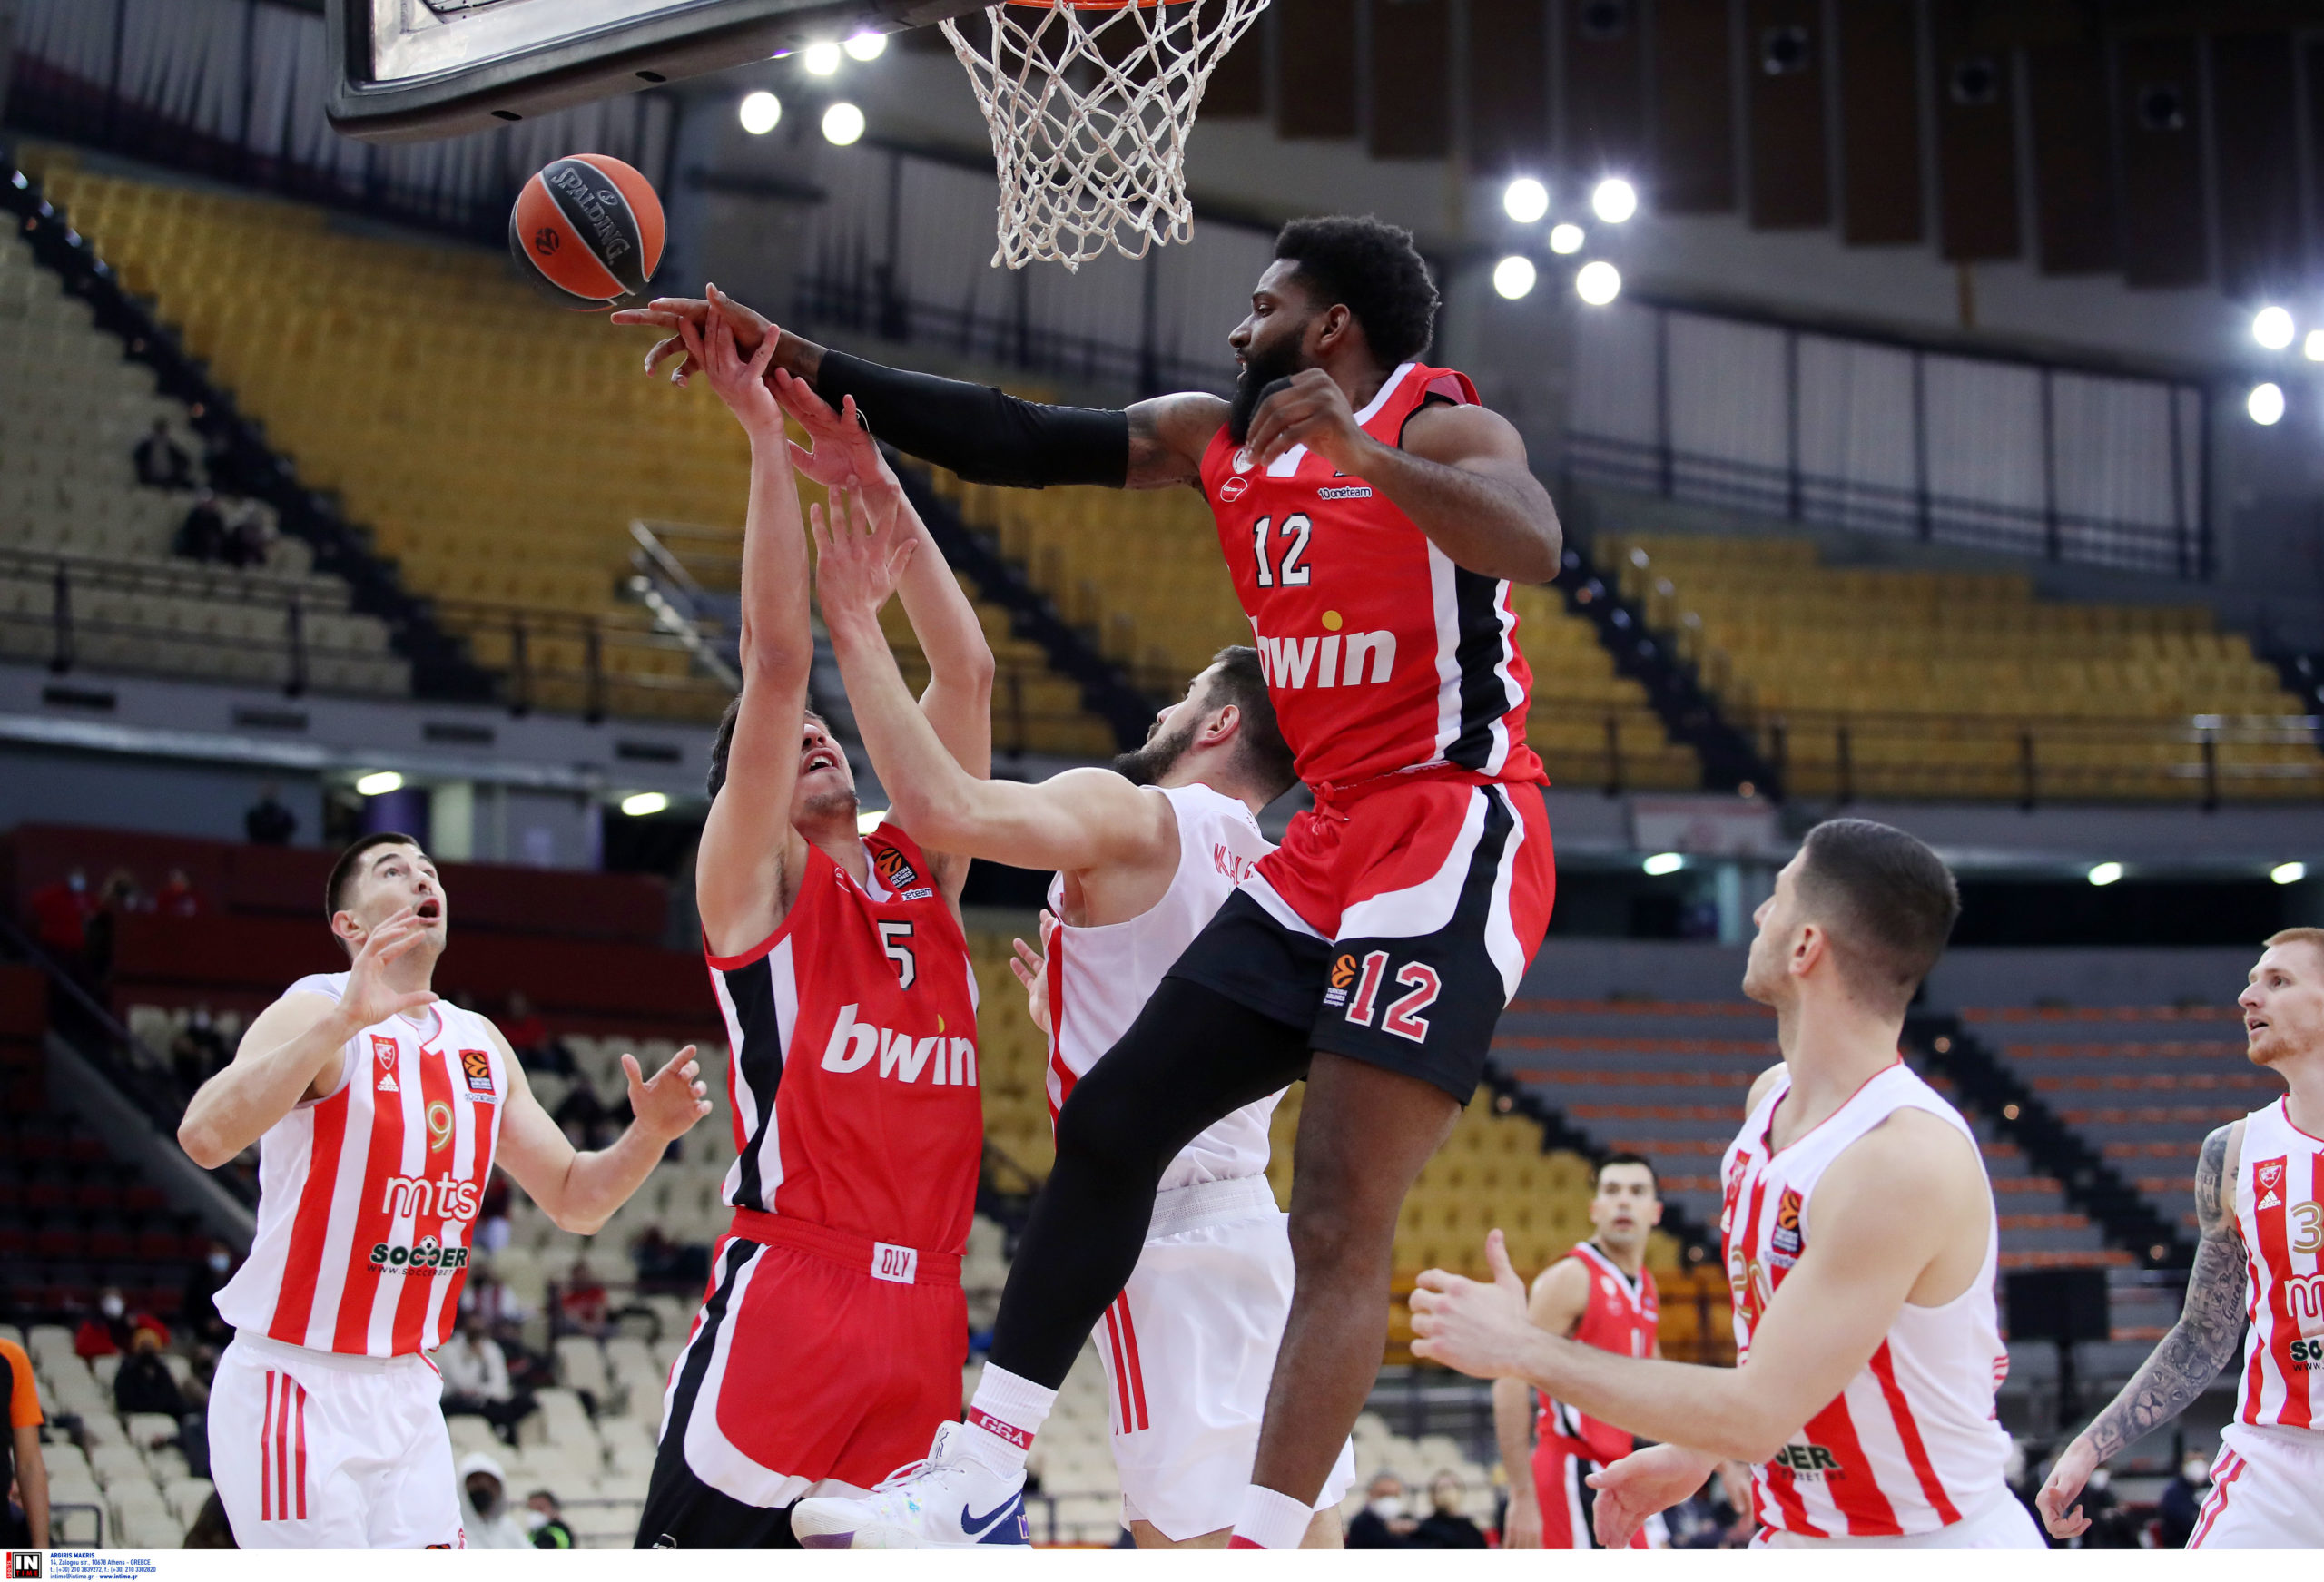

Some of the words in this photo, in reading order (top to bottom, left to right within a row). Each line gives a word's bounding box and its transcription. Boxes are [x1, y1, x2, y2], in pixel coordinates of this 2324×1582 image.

[1252, 511, 1314, 588] 12
[876, 919, 917, 991] 5
[1344, 949, 1442, 1045] 12
[820, 1002, 977, 1087] bwin
[426, 1099, 455, 1154] 9
[382, 1171, 478, 1220] mts
[369, 1241, 469, 1268] SOCCER
[881, 1248, 911, 1277] OLY
[980, 1415, 1025, 1448] GSA
